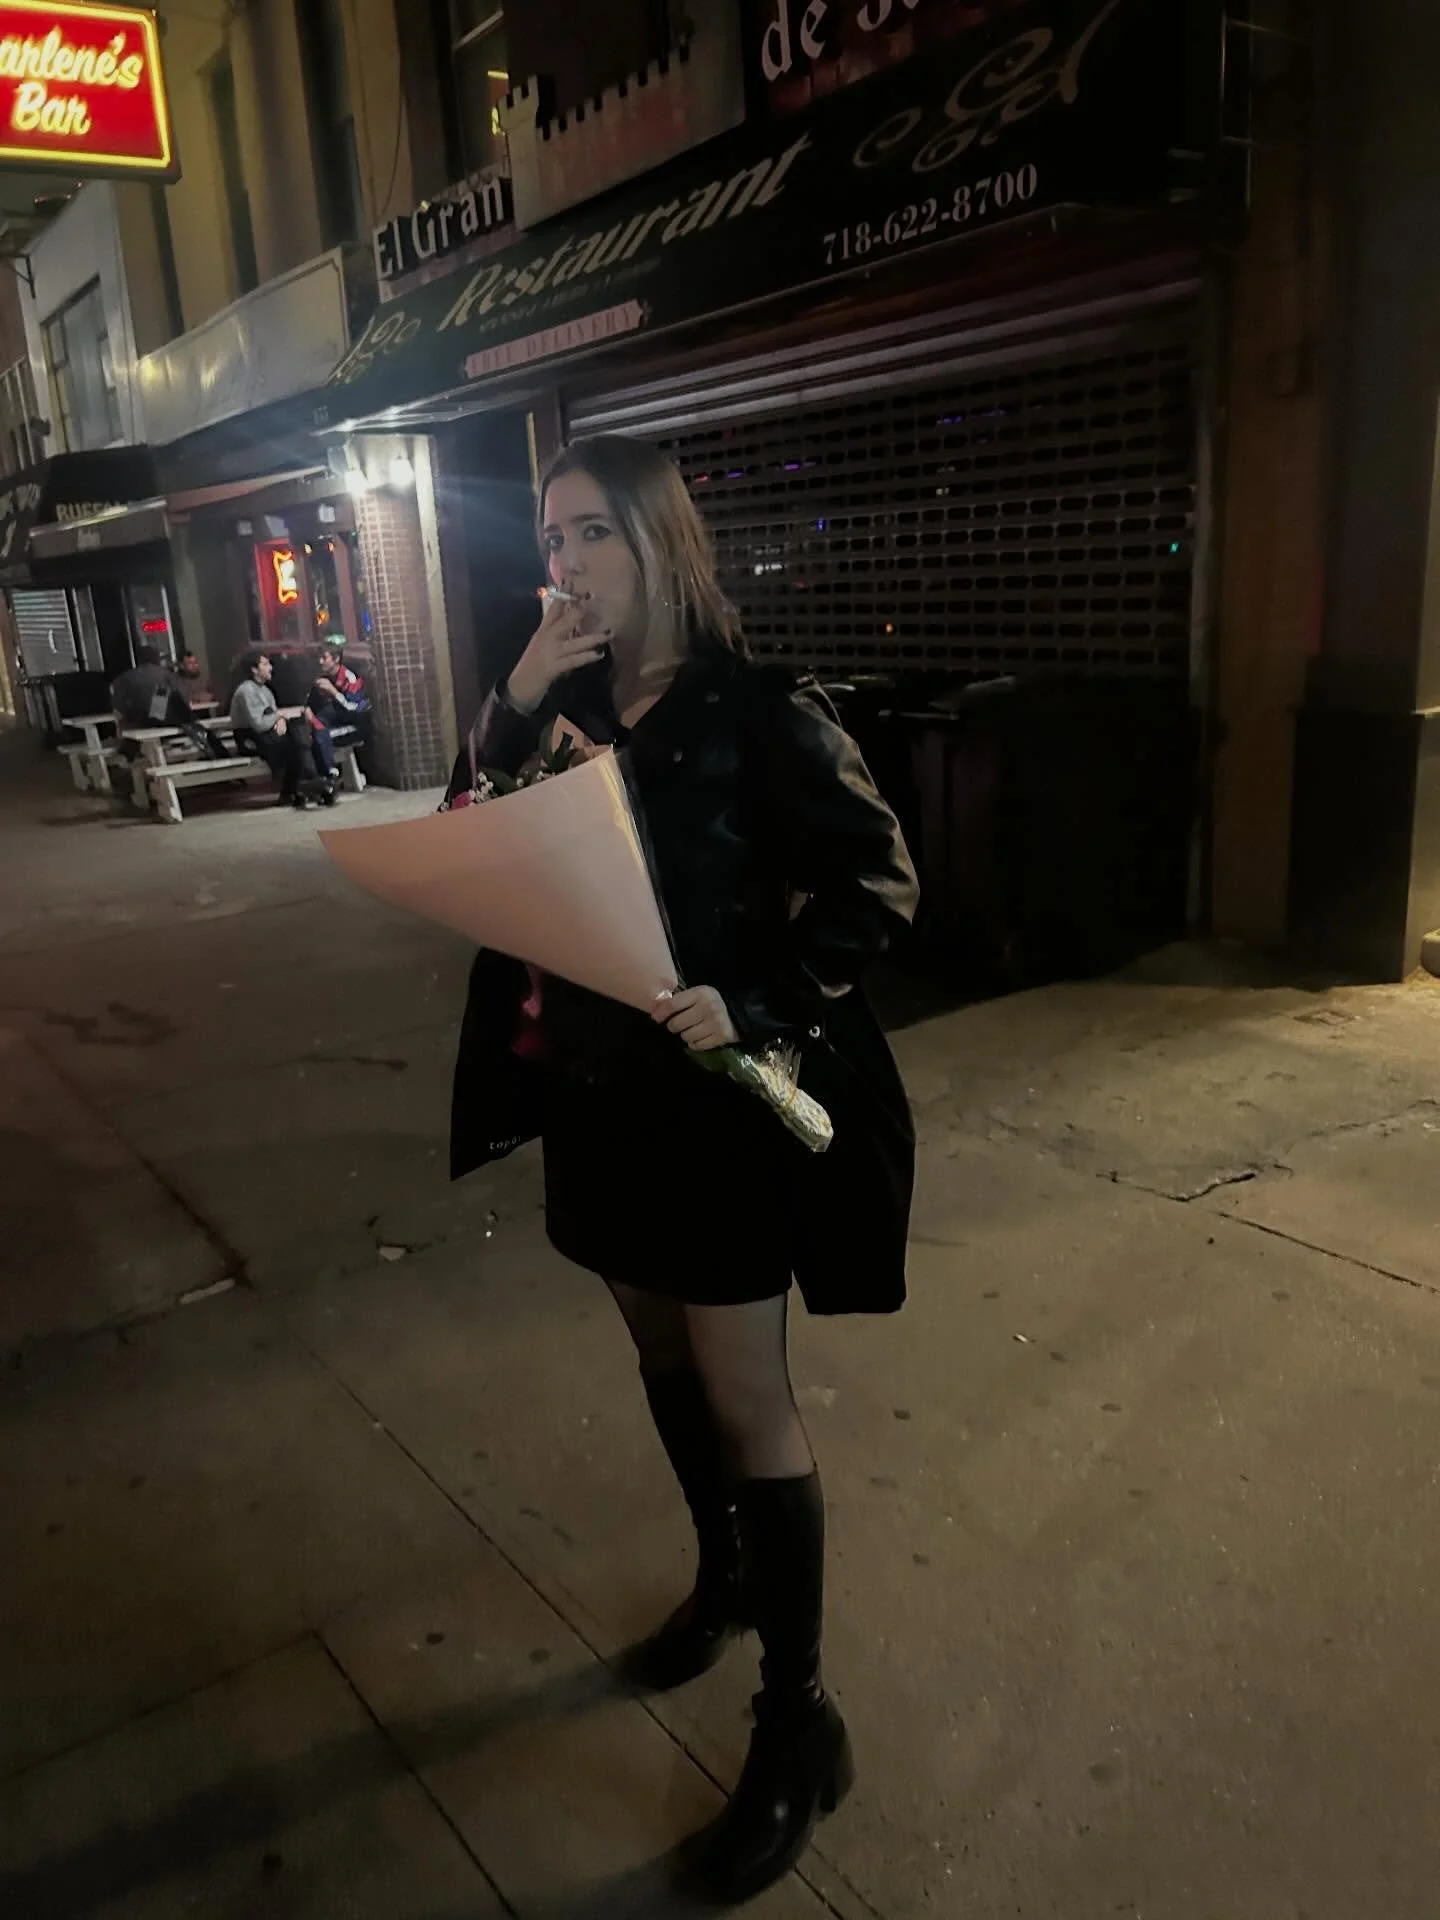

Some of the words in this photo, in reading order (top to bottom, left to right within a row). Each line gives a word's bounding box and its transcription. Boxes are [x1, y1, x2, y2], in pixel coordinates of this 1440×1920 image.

[762, 0, 829, 82] de
[12, 81, 92, 135] Bar
[373, 216, 404, 280] El
[411, 178, 505, 260] Gran
[436, 128, 813, 333] Restaurant
[821, 162, 1038, 265] 718-622-8700
